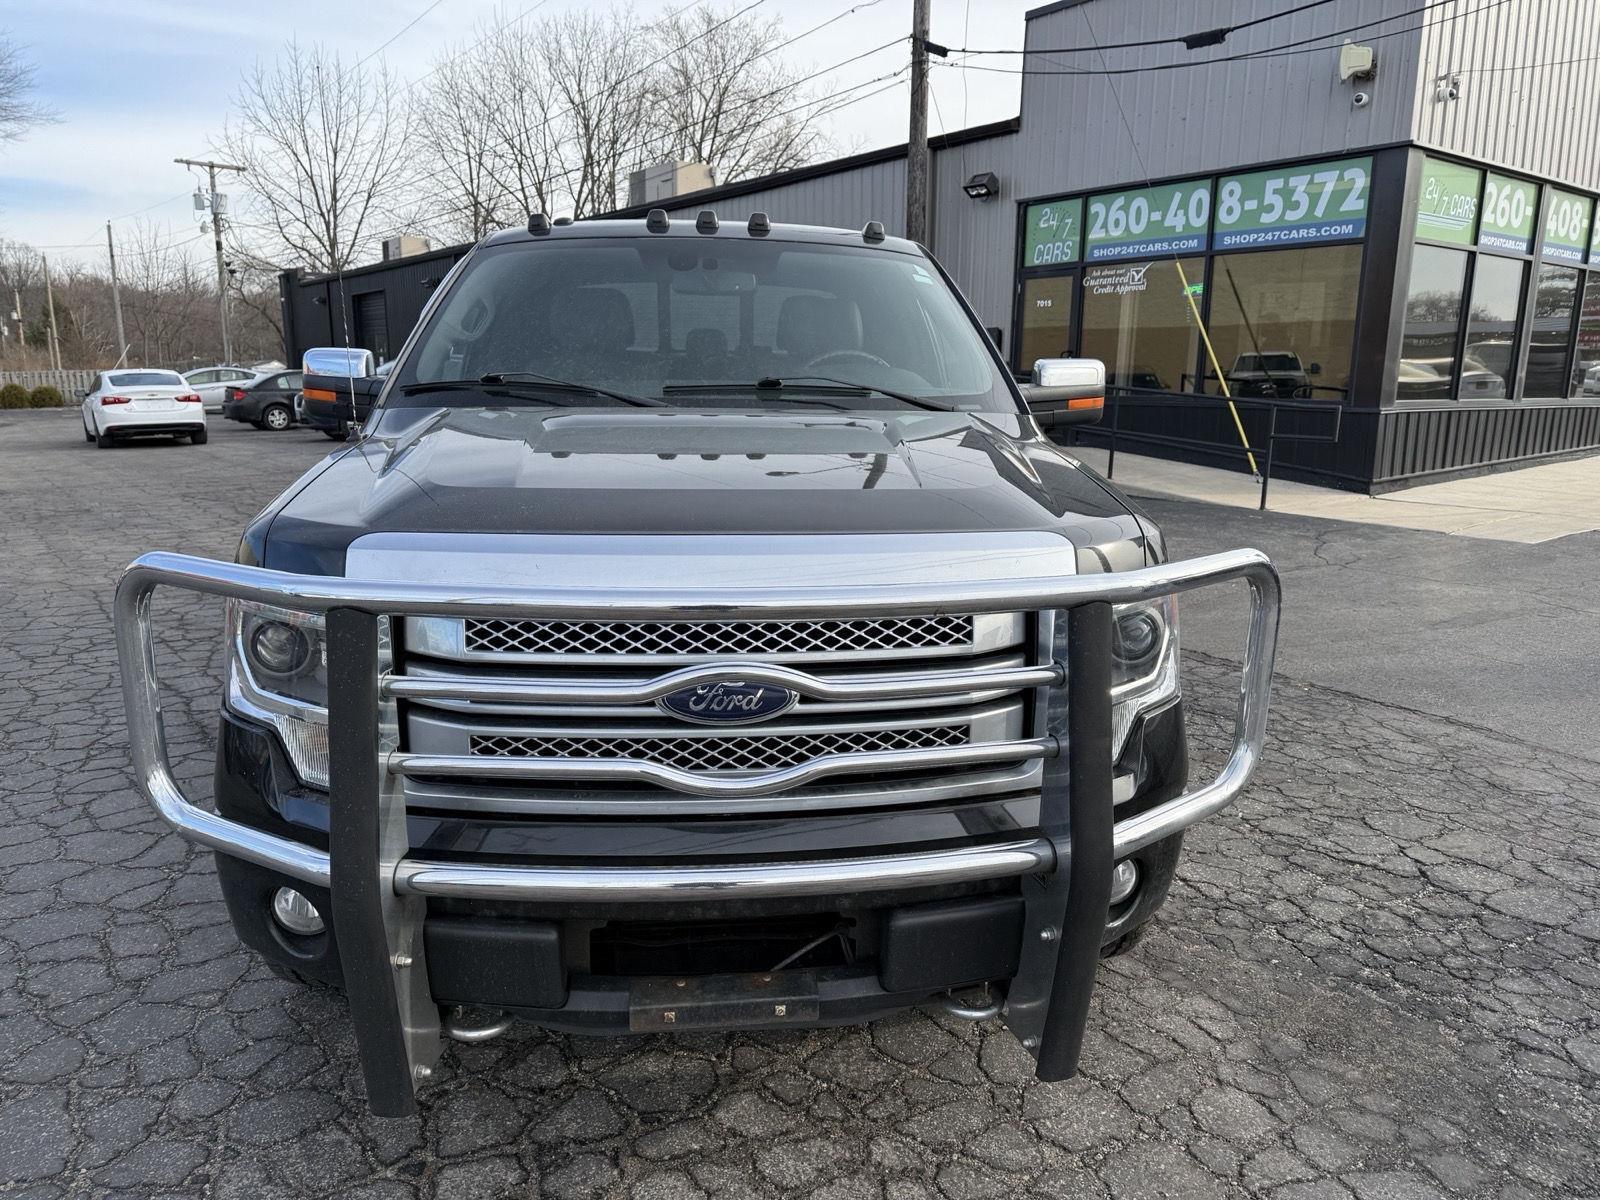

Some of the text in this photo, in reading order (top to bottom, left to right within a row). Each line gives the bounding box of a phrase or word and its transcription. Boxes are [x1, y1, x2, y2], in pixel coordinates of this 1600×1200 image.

[1450, 194, 1477, 219] CARS
[1223, 224, 1354, 245] SHOP247CARS.COM
[1033, 241, 1073, 264] CARS
[1093, 239, 1199, 257] SHOP247CARS.COM
[1083, 272, 1130, 287] Guaranteed
[1093, 281, 1147, 295] Credit Approval
[689, 681, 765, 711] Ford
